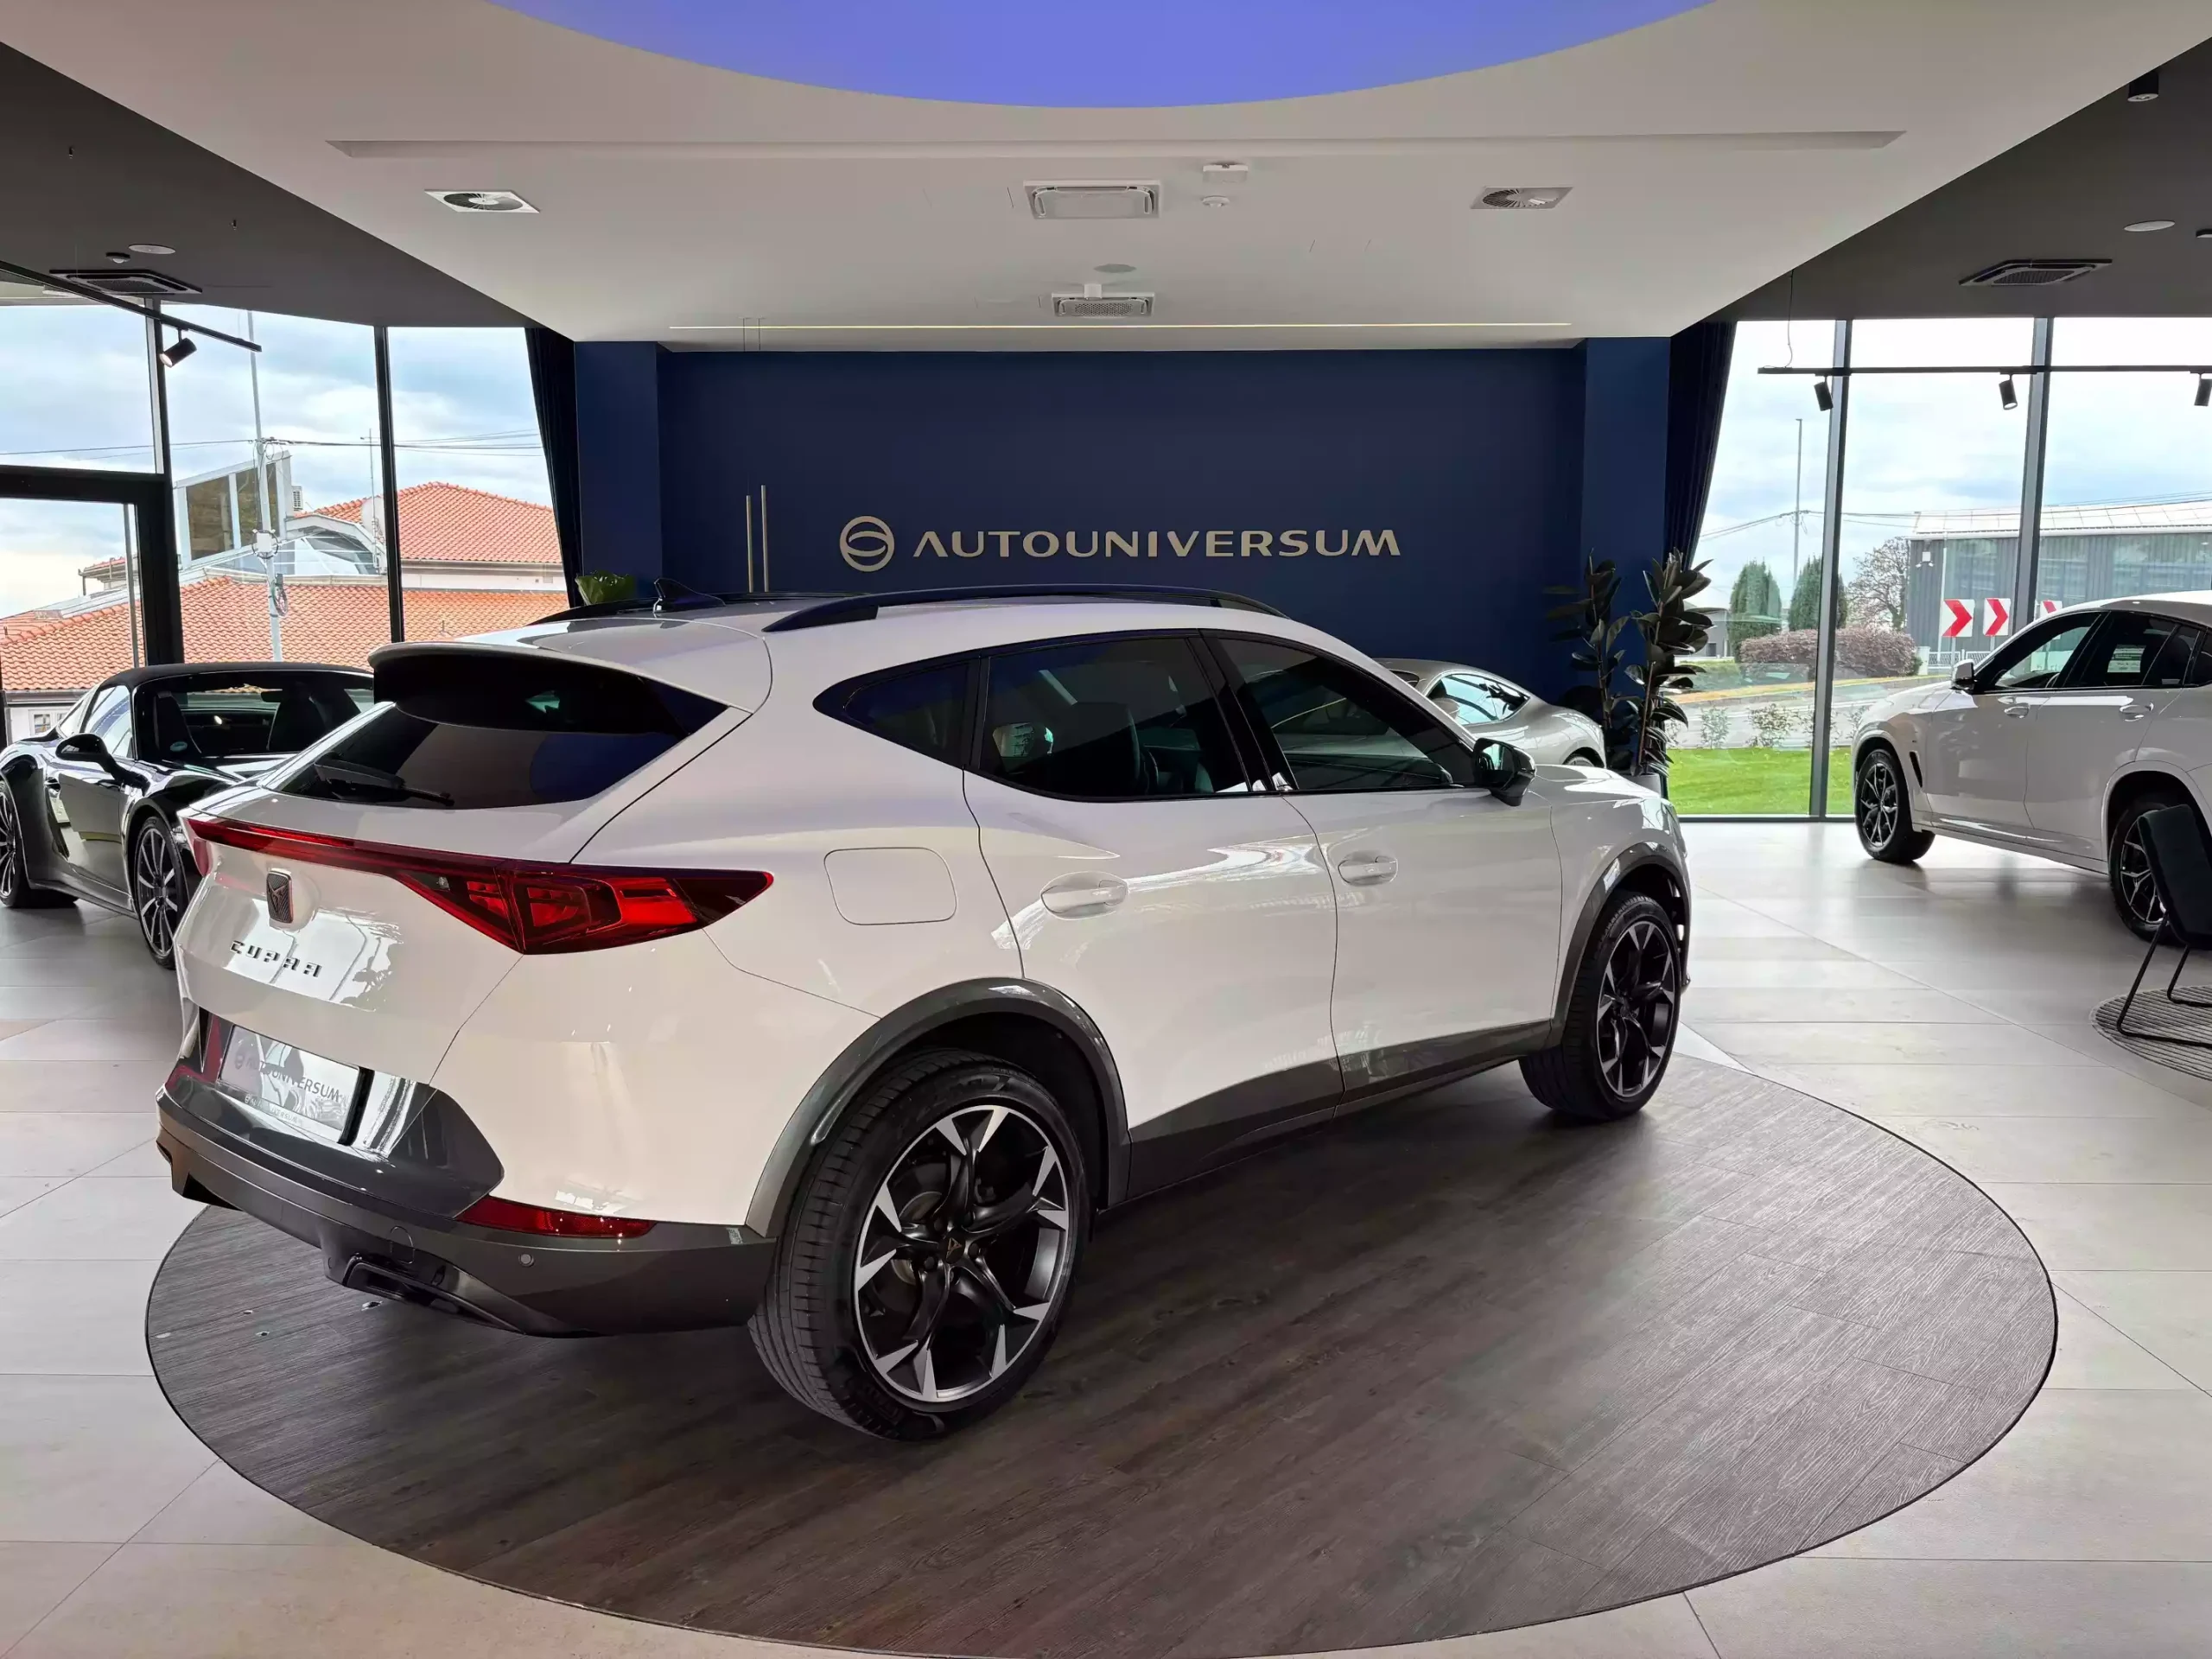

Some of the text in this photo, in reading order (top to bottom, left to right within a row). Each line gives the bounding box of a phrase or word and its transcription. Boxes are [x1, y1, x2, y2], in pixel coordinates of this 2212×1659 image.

[912, 529, 1401, 557] AUTOUNIVERSUM
[230, 940, 322, 978] CUPRA
[245, 1056, 340, 1103] AUTUNIERSUM
